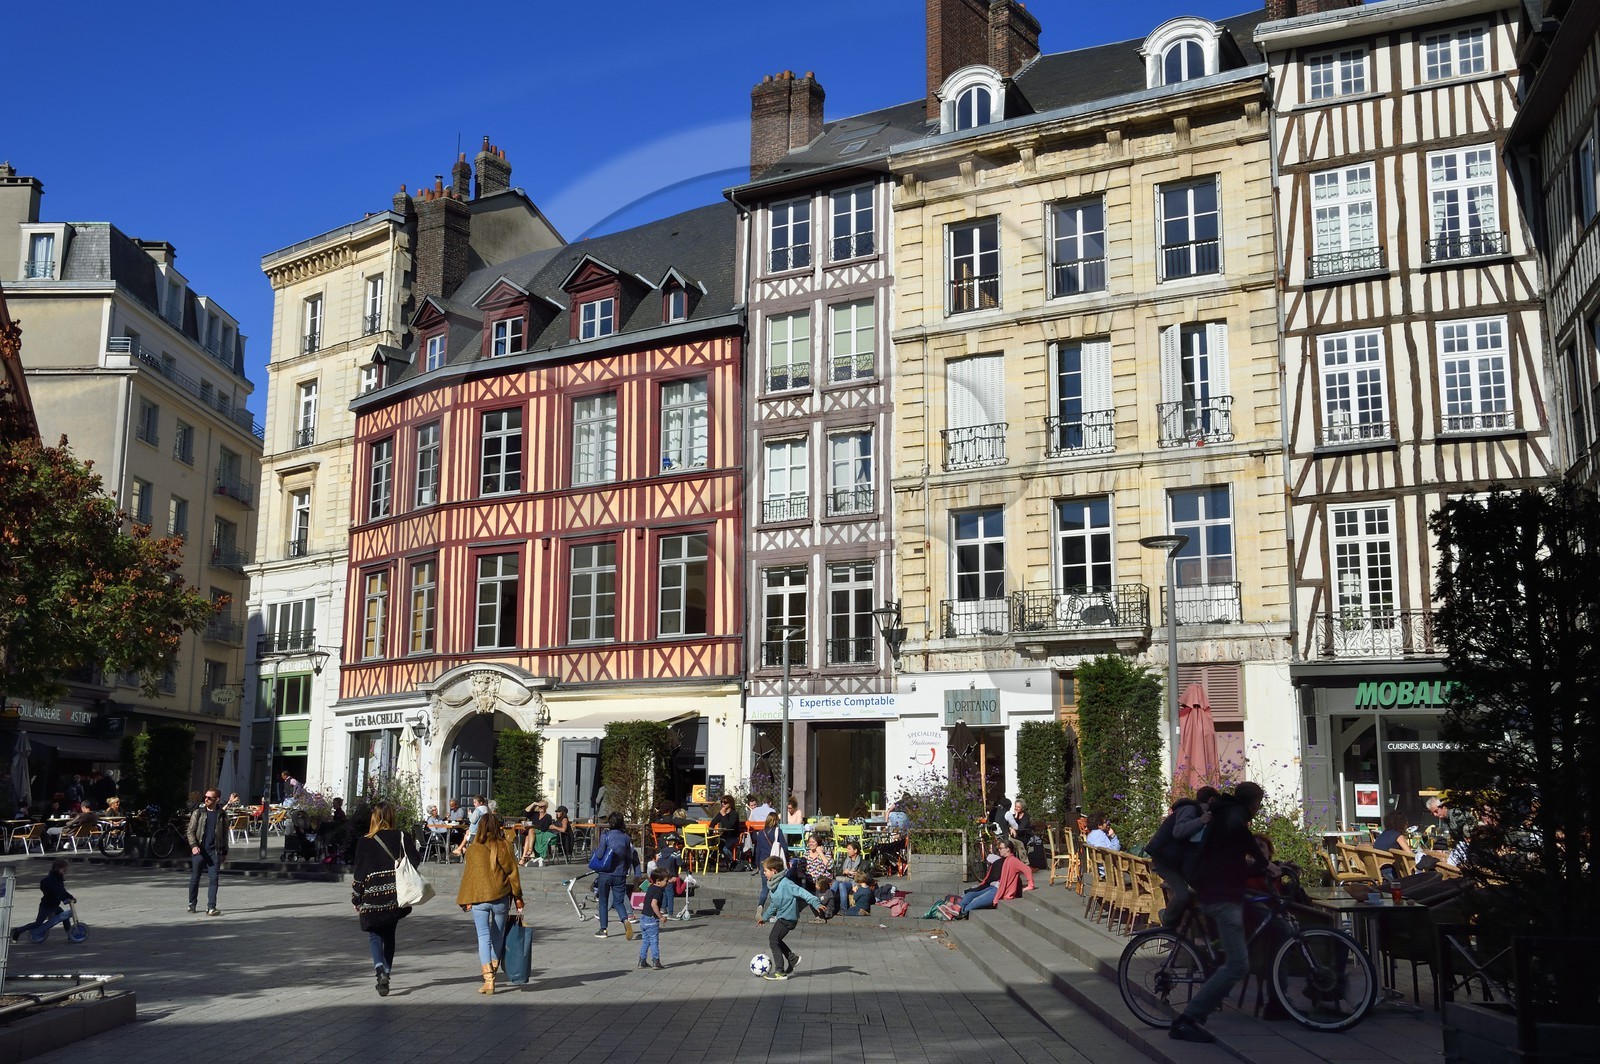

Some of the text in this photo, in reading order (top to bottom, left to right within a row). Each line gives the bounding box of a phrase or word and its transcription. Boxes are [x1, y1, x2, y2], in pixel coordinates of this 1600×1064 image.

[800, 696, 895, 709] Expertise Comptable
[354, 716, 367, 727] Eric
[367, 712, 404, 726] BACHELET
[1387, 742, 1420, 751] CUISINES,
[1421, 742, 1444, 750] BAINS
